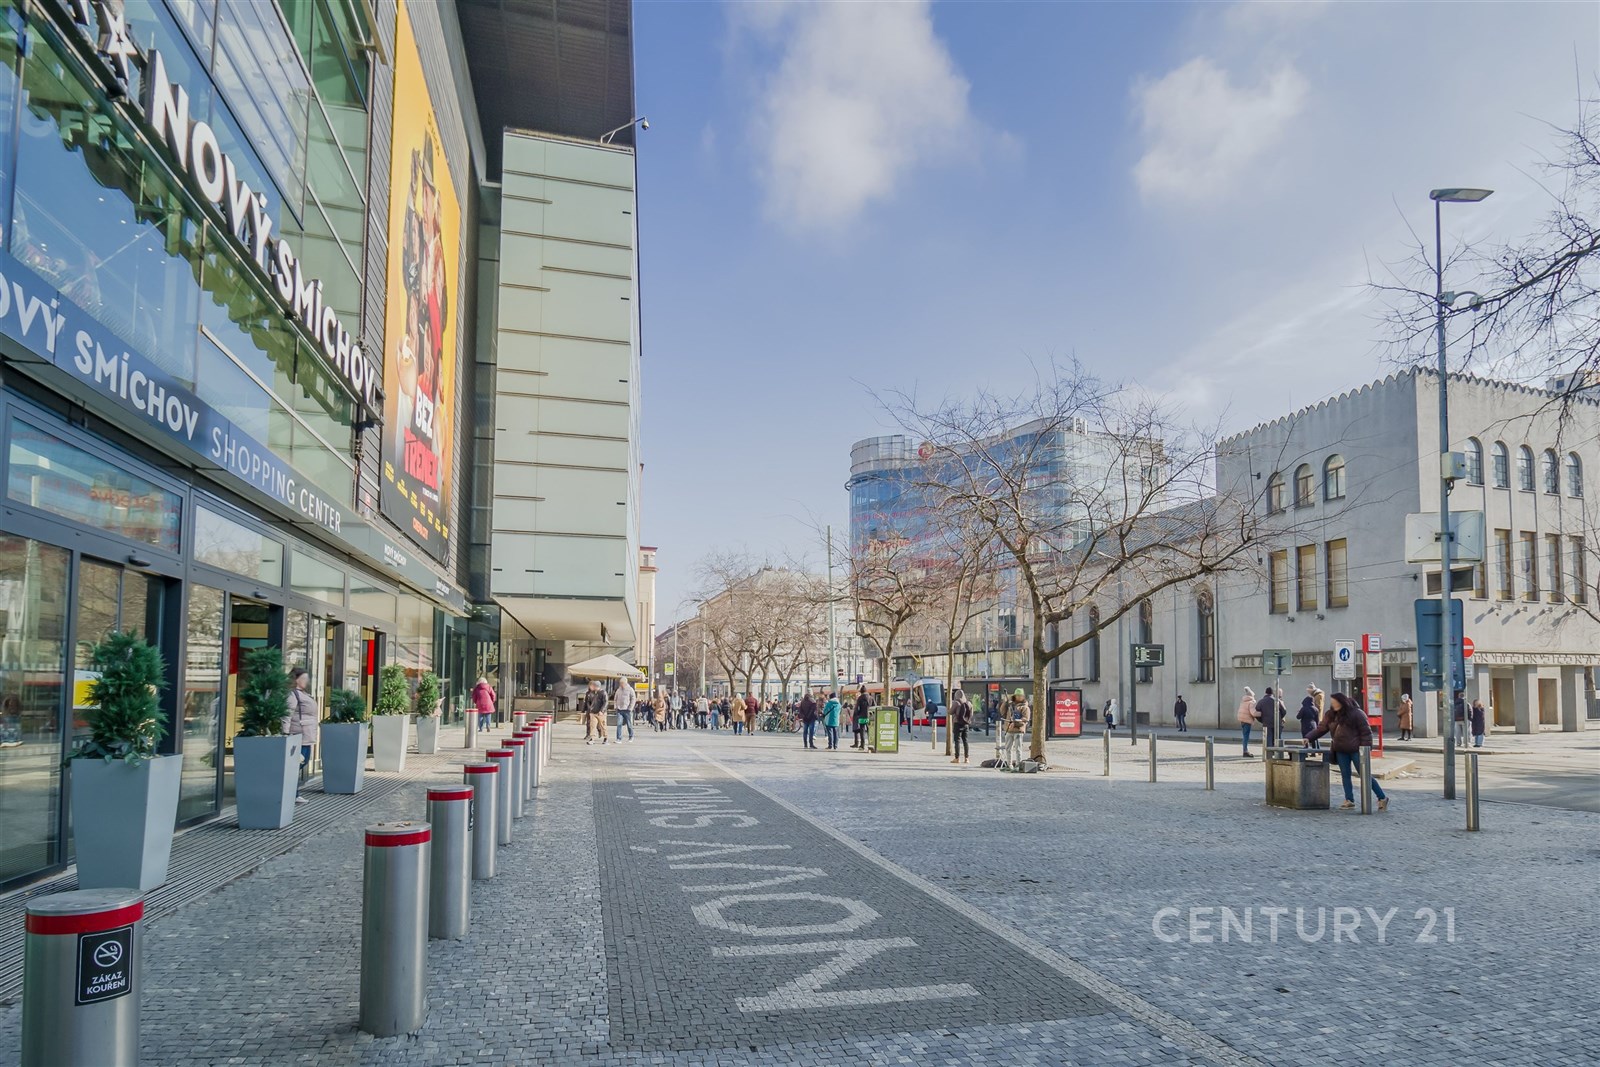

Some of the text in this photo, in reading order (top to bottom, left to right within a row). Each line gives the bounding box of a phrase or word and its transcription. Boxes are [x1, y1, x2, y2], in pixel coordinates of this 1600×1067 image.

[146, 49, 374, 404] NOVÝ SMÍCHOV
[73, 330, 199, 441] SMÍCHOV
[212, 426, 295, 504] SHOPPING
[300, 489, 341, 533] CENTER
[416, 385, 434, 440] BEZ
[92, 971, 122, 985] ZÁKAZ
[629, 839, 982, 1012] NOVÝ
[86, 977, 126, 995] KOUŘENÍ
